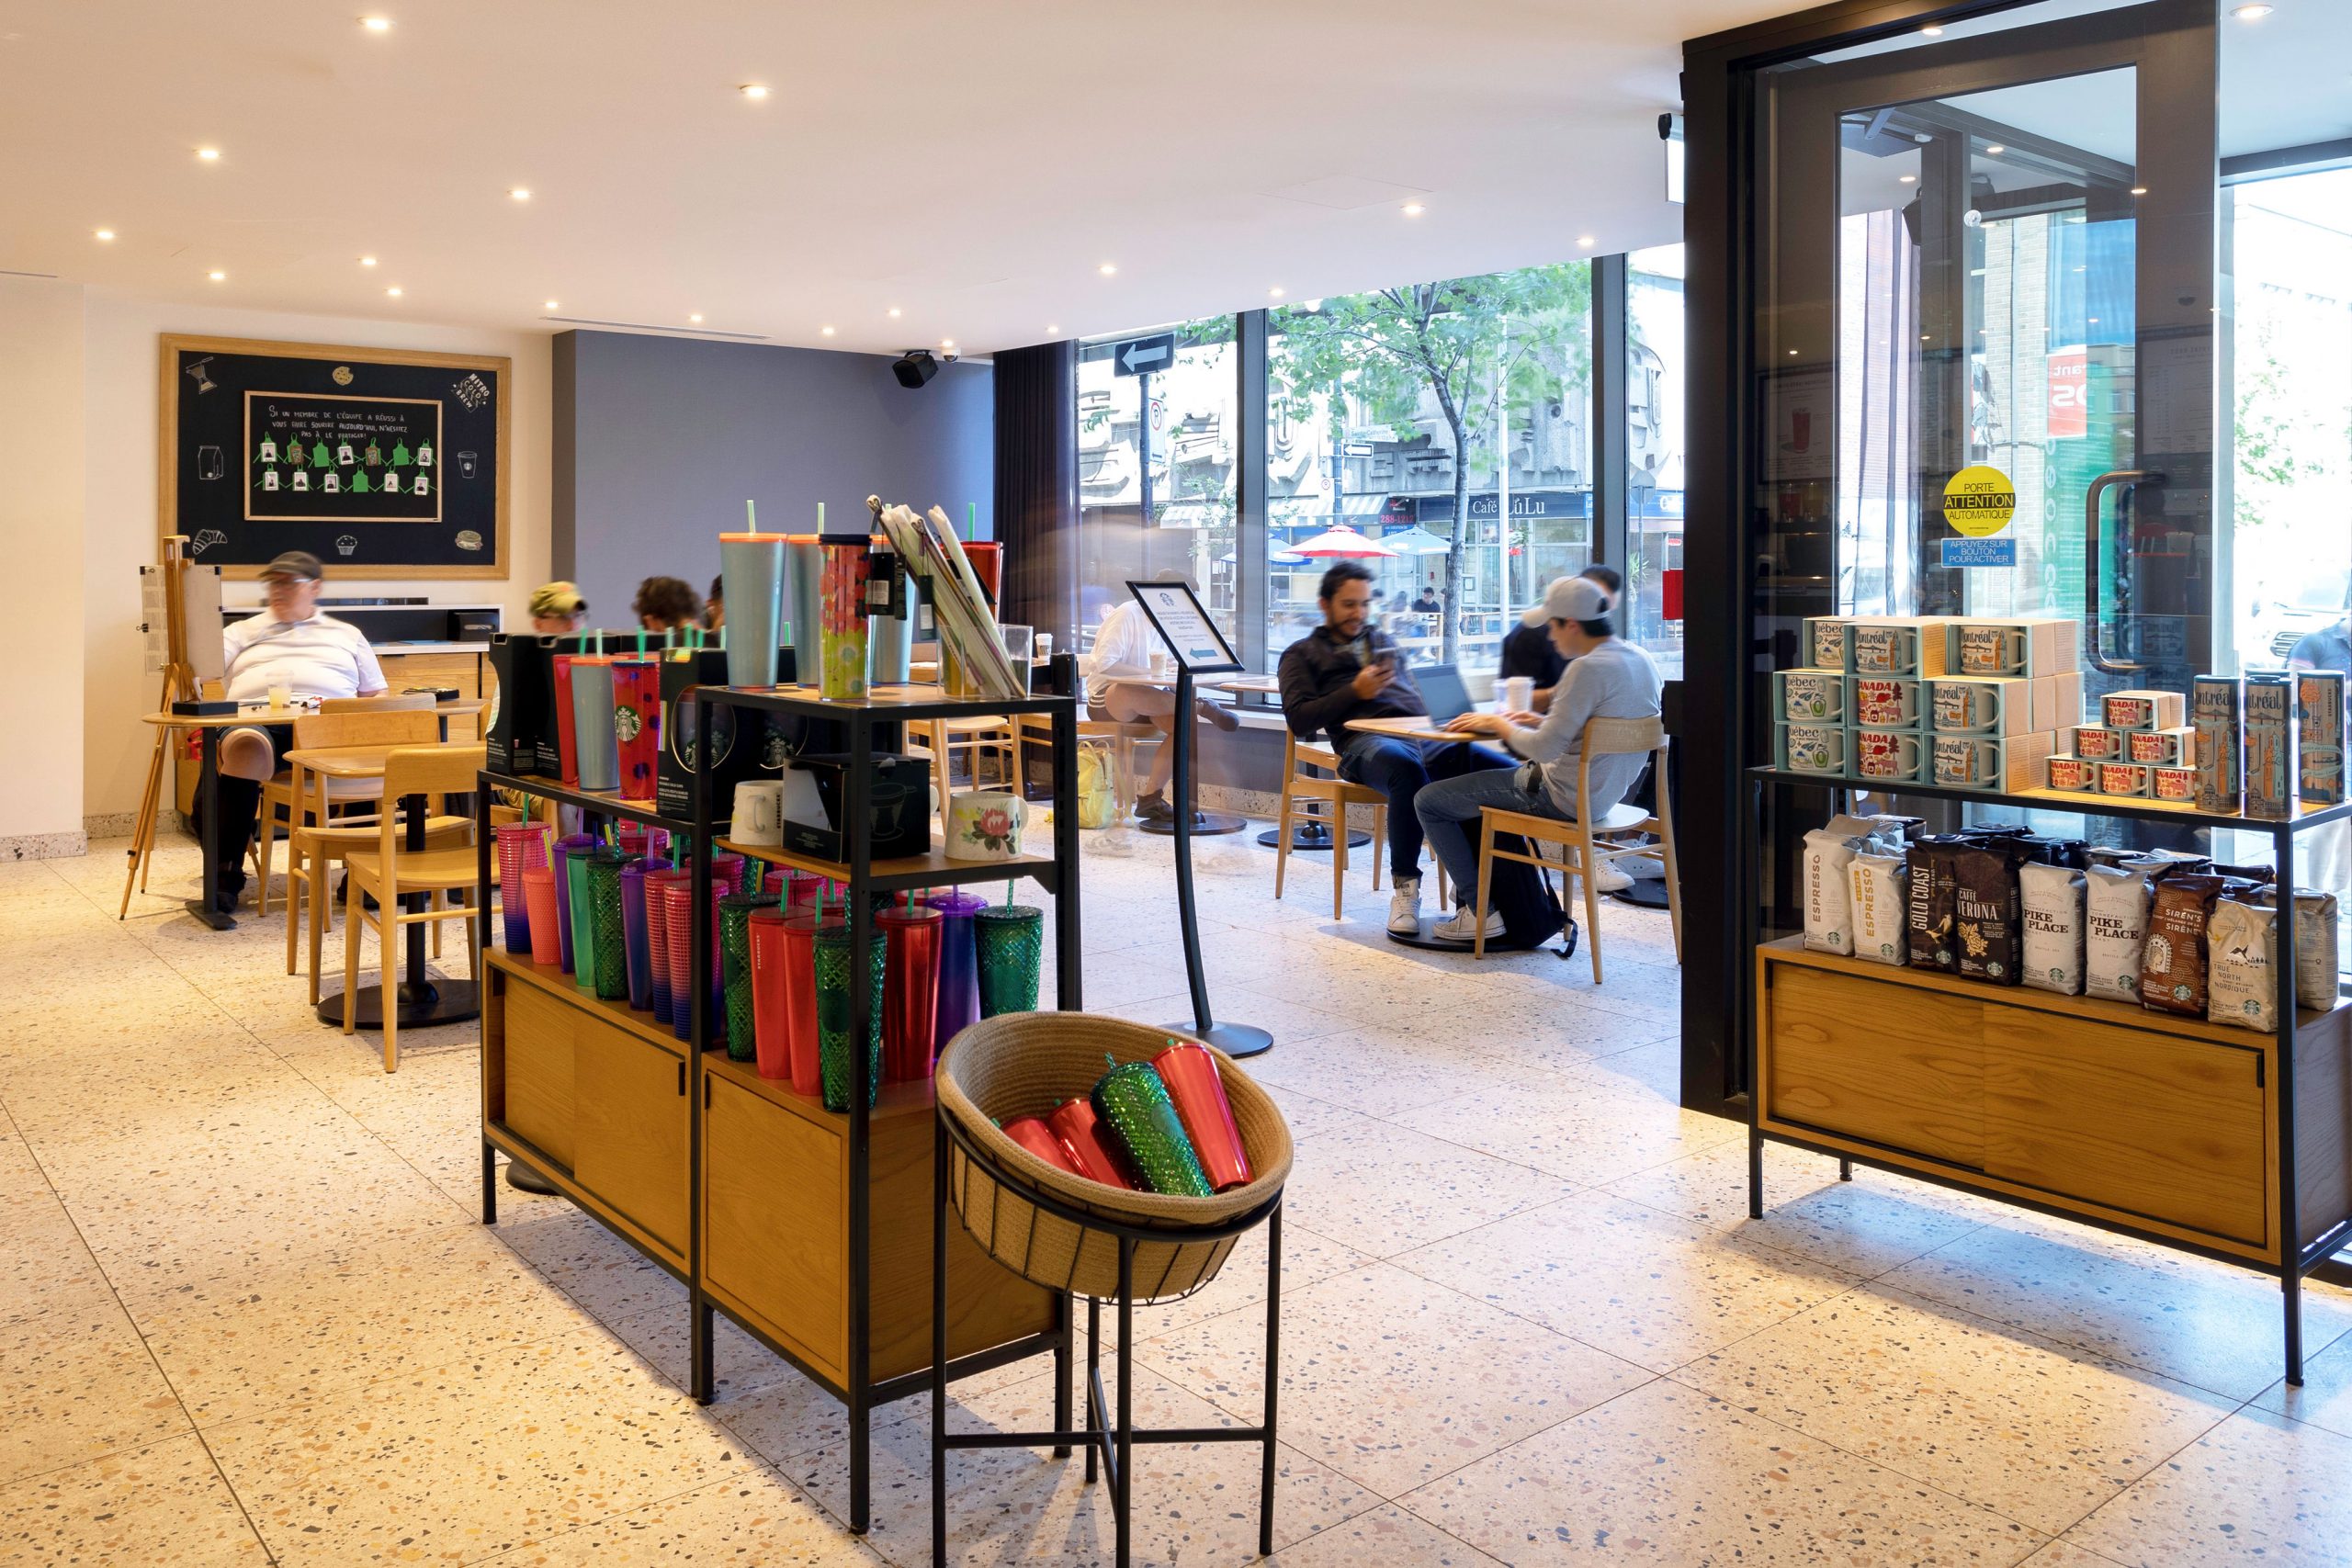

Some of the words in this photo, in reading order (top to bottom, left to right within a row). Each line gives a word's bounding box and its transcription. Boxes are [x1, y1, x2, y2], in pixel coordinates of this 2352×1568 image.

[464, 380, 481, 399] COLD
[469, 373, 490, 397] NITRO
[456, 389, 472, 408] BREW
[1963, 482, 1995, 492] PORTE
[1472, 499, 1498, 513] Café
[1944, 494, 2013, 508] ATTENTION
[1949, 510, 2010, 520] AUTOMATIQUE
[1950, 540, 1988, 548] APPUYEZ
[1961, 547, 1996, 556] BOUTON
[1949, 555, 1973, 563] POUR
[1973, 555, 2009, 563] ACTIVER
[1815, 623, 1843, 634] uébec
[1786, 676, 1816, 687] uébec
[1859, 682, 1893, 691] ANADA
[1788, 726, 1819, 737] uébec
[1812, 854, 1821, 923] ESPRESSO
[1912, 864, 1930, 899] COAST
[1862, 868, 1875, 937] ESPRESSO
[1957, 899, 1998, 920] VERONA
[1911, 901, 1928, 931] GOLD
[2023, 908, 2053, 922] PIKE
[2089, 915, 2123, 929] PIKE
[2028, 919, 2069, 933] PLACE
[2094, 926, 2139, 940] PLACE
[2213, 963, 2230, 973] TRUE
[2217, 971, 2241, 982] NORTH
[2214, 981, 2250, 994] NORDIQUE
